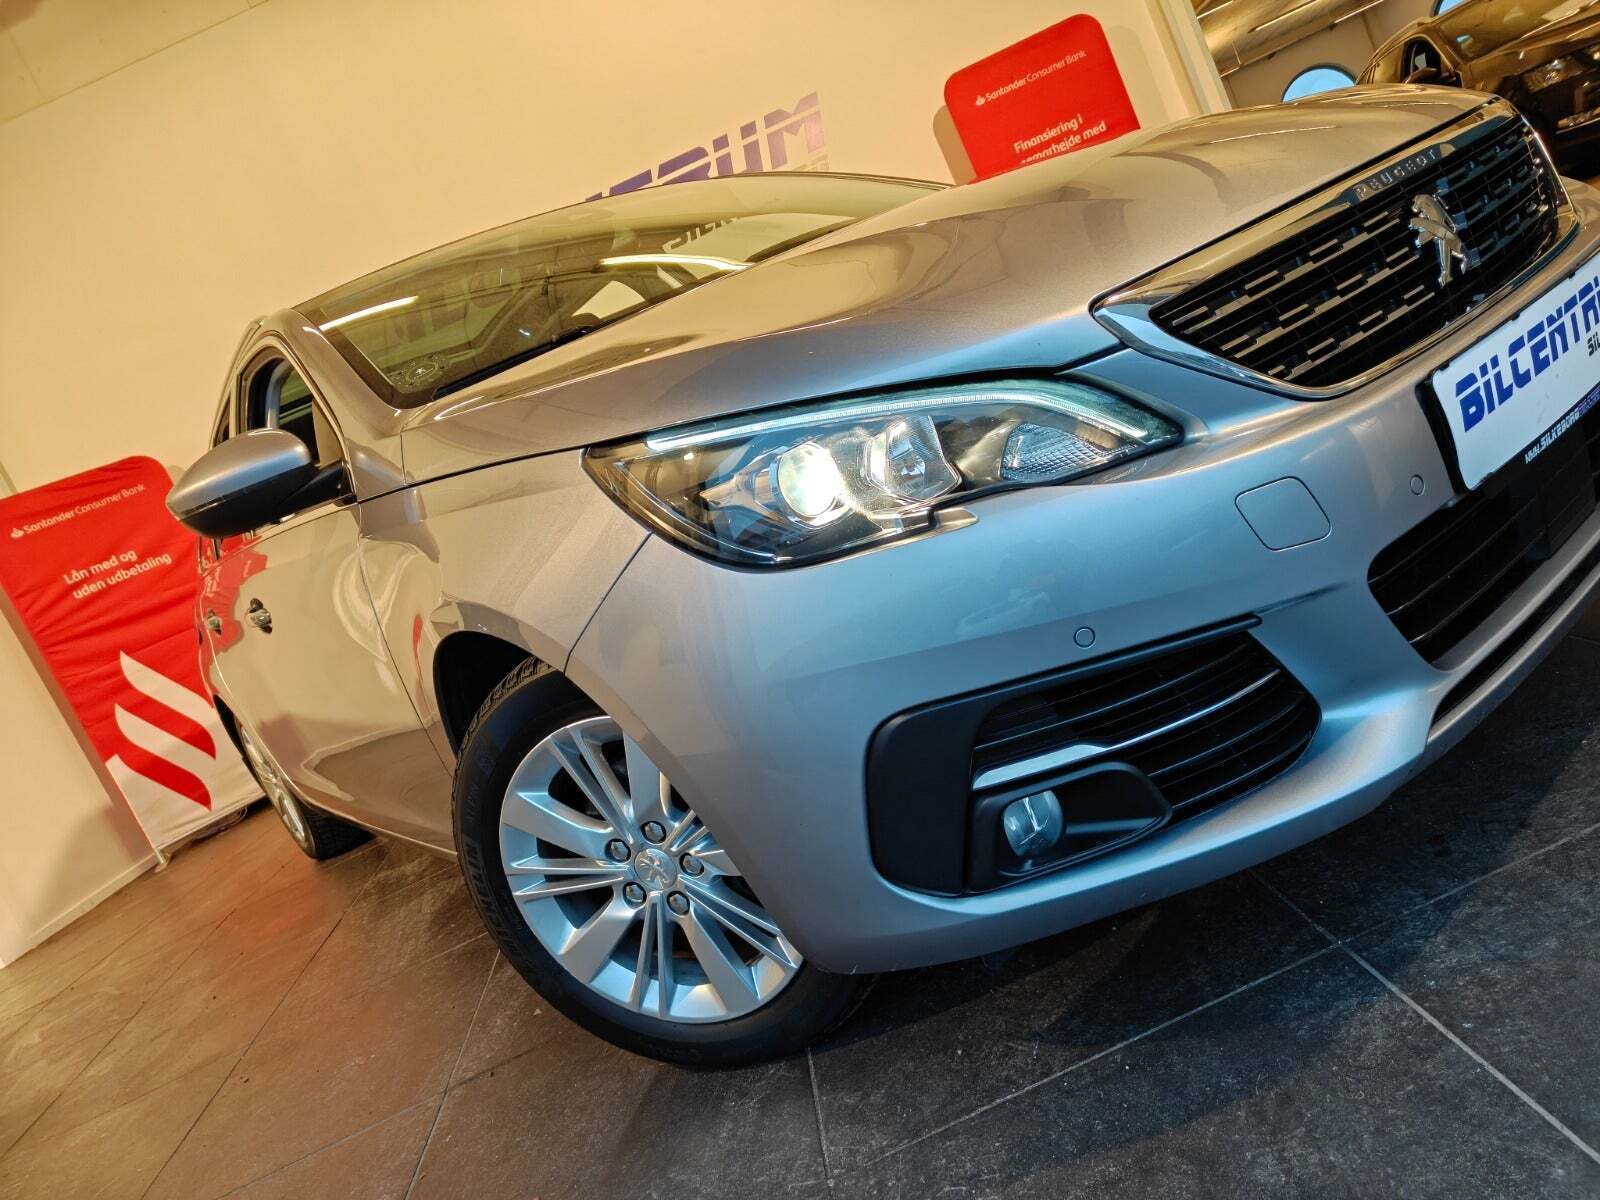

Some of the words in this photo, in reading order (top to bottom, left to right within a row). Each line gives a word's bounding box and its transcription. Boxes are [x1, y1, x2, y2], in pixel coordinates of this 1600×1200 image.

[1065, 48, 1087, 65] Bank
[1014, 116, 1079, 154] Finansiering
[1082, 120, 1107, 140] med
[1353, 148, 1436, 201] PEUGEOT
[122, 483, 146, 499] Bank
[63, 566, 89, 585] Lån
[91, 555, 119, 576] med
[120, 549, 138, 564] og
[73, 579, 106, 600] uden
[107, 551, 173, 586] udbetaling
